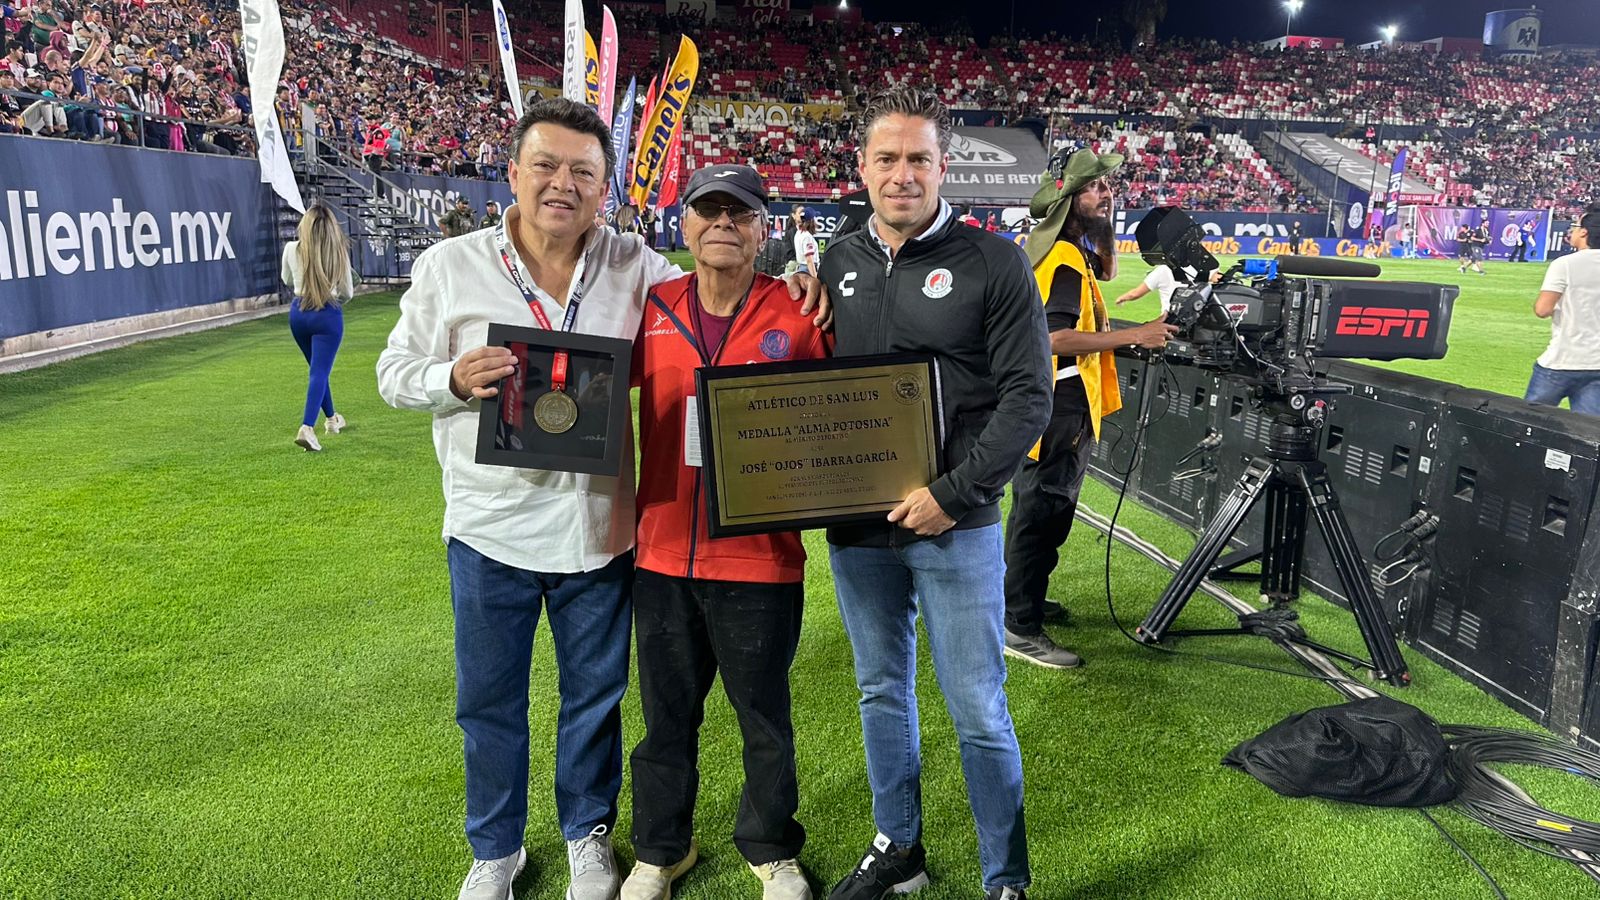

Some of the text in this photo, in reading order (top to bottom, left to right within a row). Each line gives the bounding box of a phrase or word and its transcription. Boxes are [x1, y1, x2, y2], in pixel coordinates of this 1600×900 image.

[752, 9, 780, 24] Cola
[636, 73, 690, 188] Canel's
[945, 173, 980, 184] ILLA
[984, 174, 1005, 184] DE
[1257, 238, 1321, 256] Canl's
[1335, 306, 1430, 338] ESPN
[748, 390, 879, 411] ATLÉTICO DE SAN LUIS
[737, 426, 792, 440] MEDALLA
[740, 461, 768, 475] JOSÉ
[811, 455, 854, 469] IBARRA
[855, 450, 898, 463] GARCÍA
